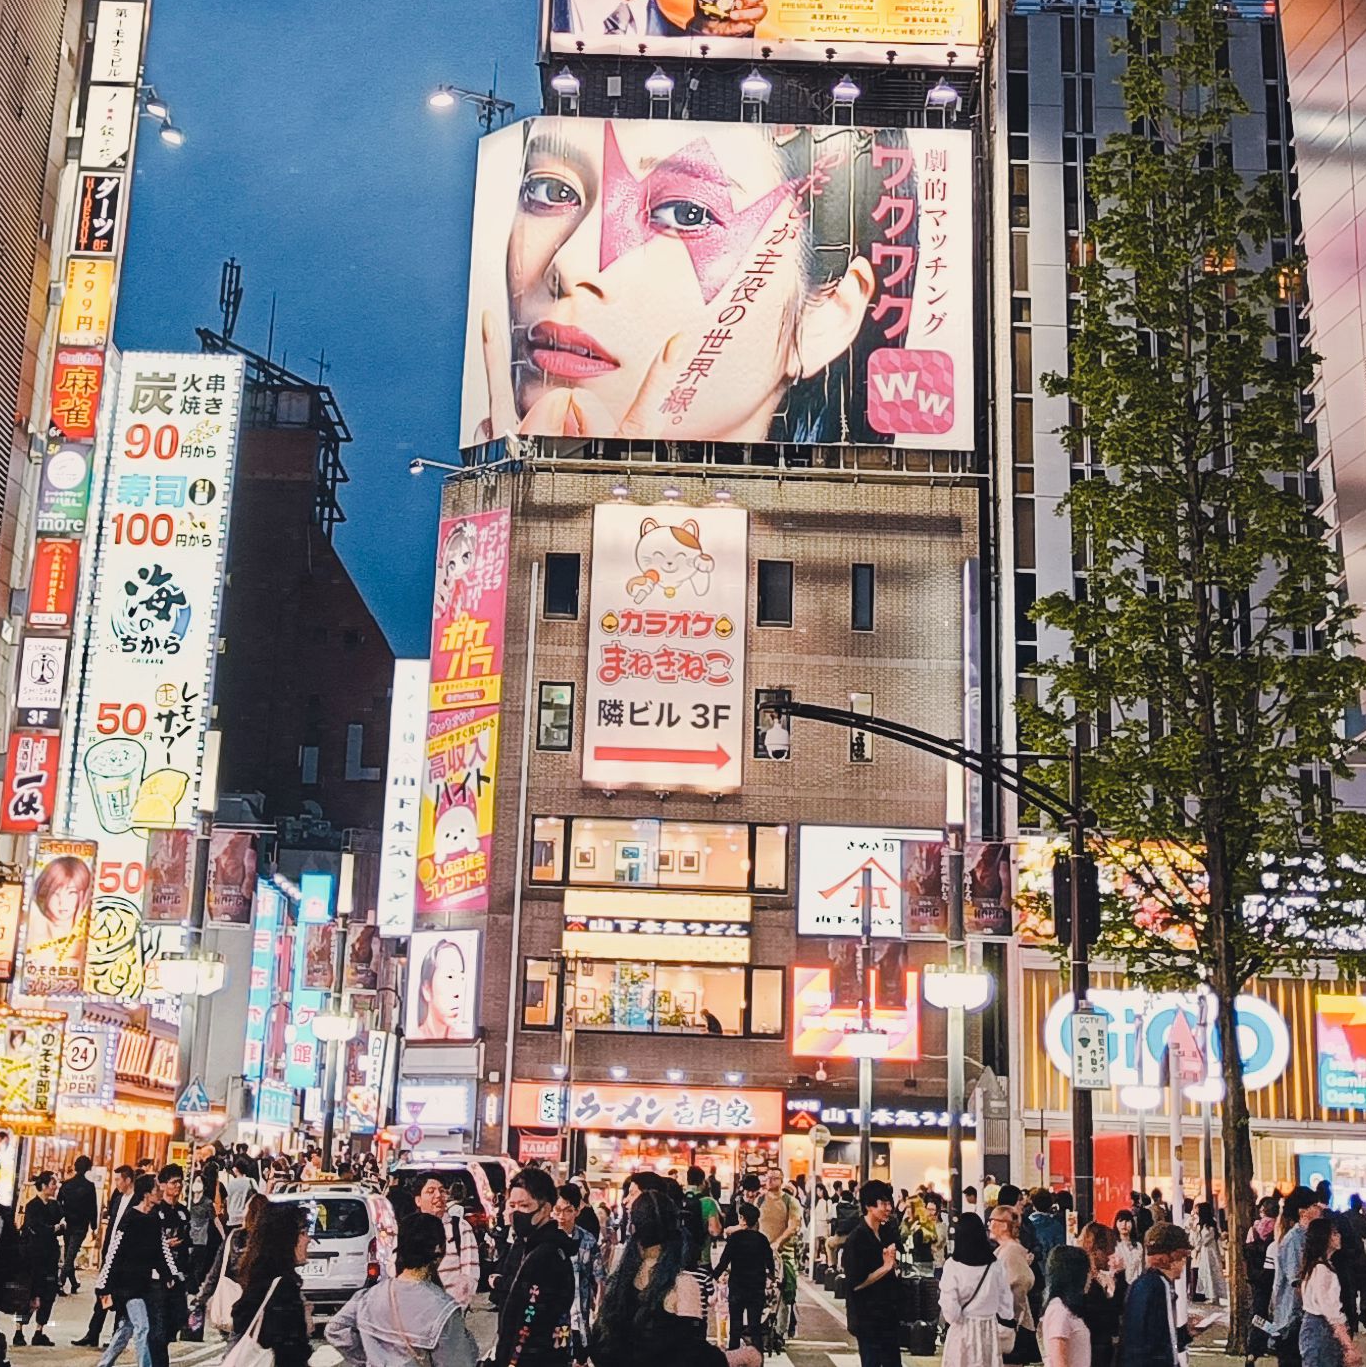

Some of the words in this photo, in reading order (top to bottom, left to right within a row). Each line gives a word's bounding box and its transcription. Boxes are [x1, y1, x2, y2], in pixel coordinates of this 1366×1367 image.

[78, 177, 95, 251] HIDEOUT
[93, 176, 120, 238] ダーツ
[92, 238, 109, 251] 8F
[870, 144, 916, 341] ワクワク
[924, 148, 948, 338] 劇的マッチング
[55, 366, 99, 427] 麻雀
[129, 372, 178, 416] 炭
[123, 423, 180, 461] 90
[180, 444, 217, 459] 円から
[116, 473, 188, 509] 寿司
[36, 515, 85, 533] more
[111, 512, 175, 548] 100
[174, 534, 213, 549] 円から
[483, 521, 499, 590] コンカフェ
[492, 513, 510, 592] キャバクラ
[619, 610, 715, 637] カラオケ
[120, 635, 181, 655] ちから
[598, 642, 732, 685] まねきねこ
[26, 709, 49, 726] 3F
[96, 702, 148, 736] 50
[175, 681, 199, 738] レモン
[597, 699, 682, 728] 隣ビル
[690, 702, 732, 730] 3F
[153, 709, 179, 765] サワー
[428, 737, 489, 784] 高収入
[434, 767, 491, 811] バイト
[98, 861, 145, 894] 50
[588, 918, 749, 936] 山下本気うどん
[71, 1046, 89, 1063] 24
[573, 1091, 665, 1124] ラーメン
